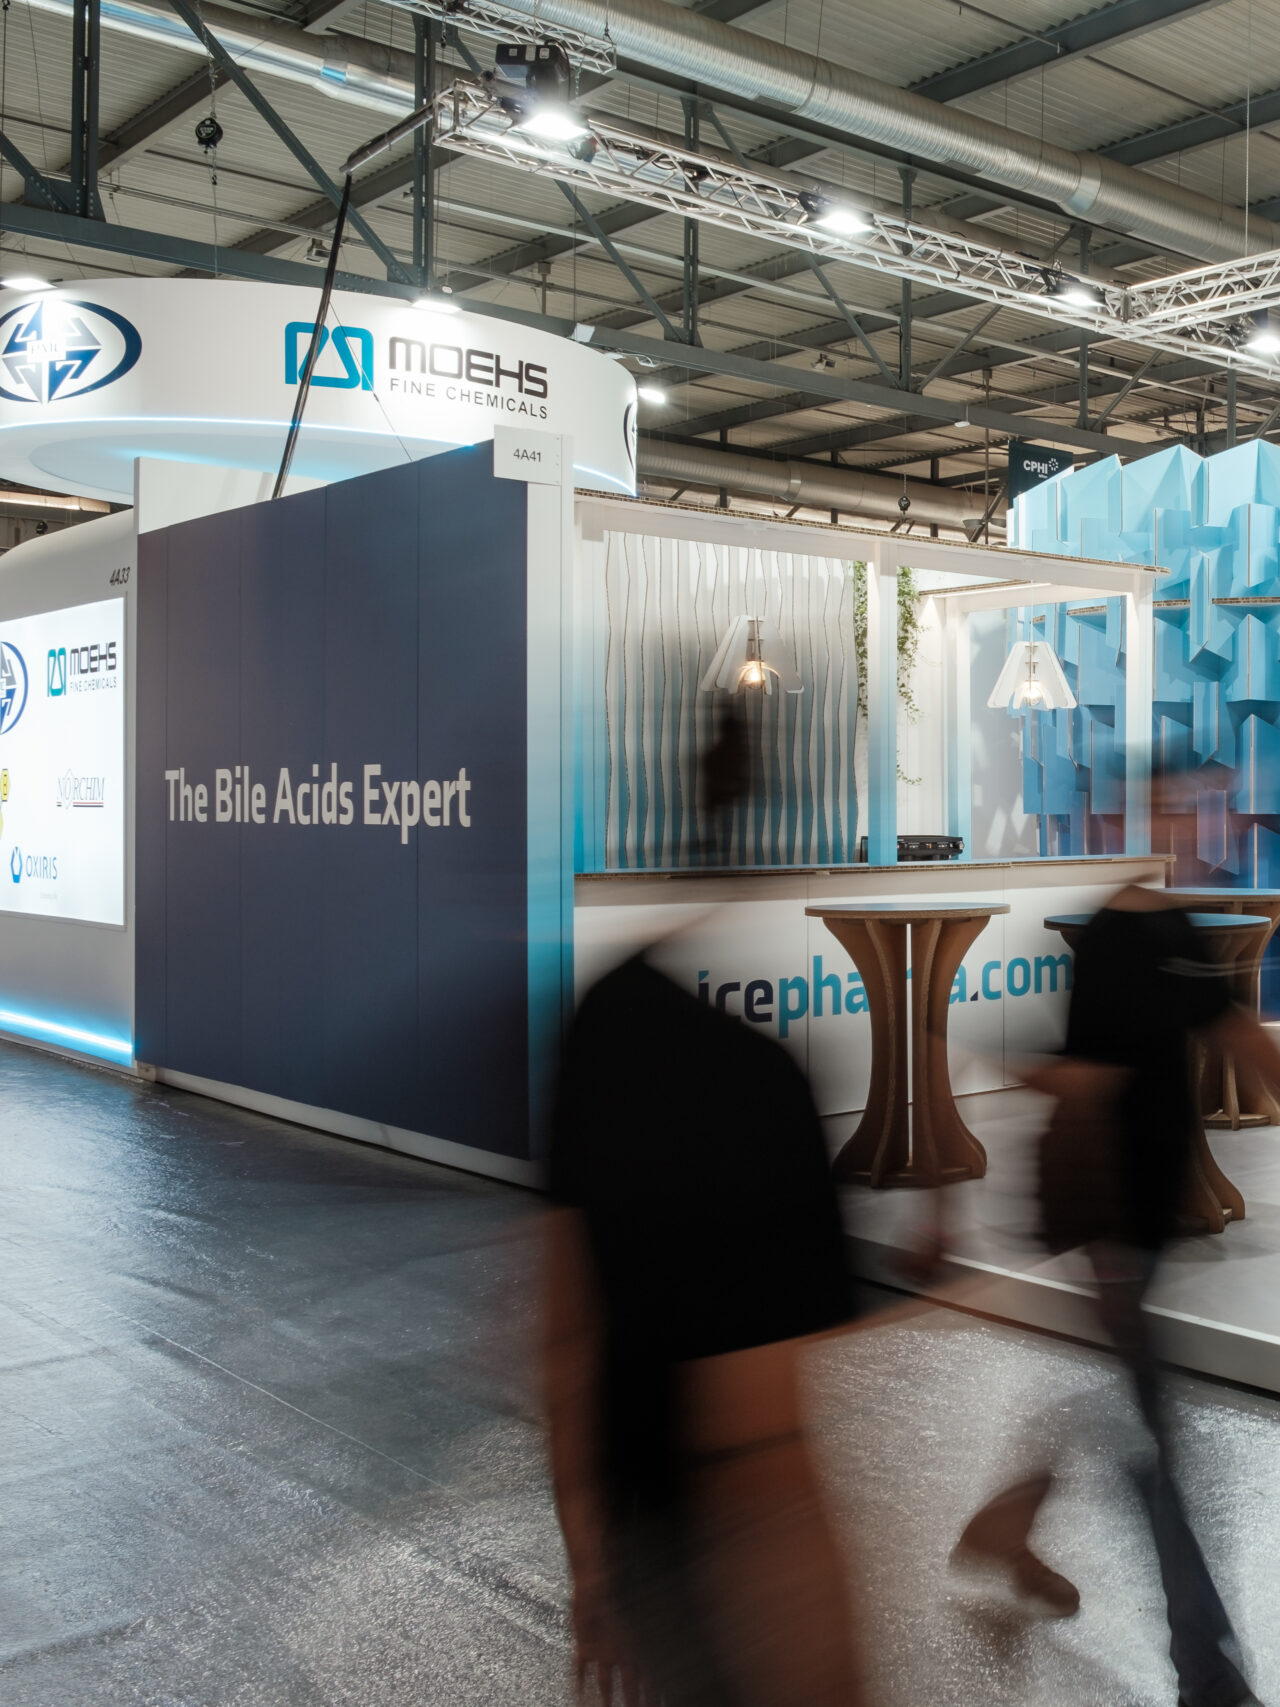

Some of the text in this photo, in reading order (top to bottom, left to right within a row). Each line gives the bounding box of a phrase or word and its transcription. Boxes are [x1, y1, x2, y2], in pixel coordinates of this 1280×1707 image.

[388, 336, 548, 399] MOEHS
[390, 378, 548, 420] FINE CHEMICALS
[513, 448, 542, 463] 4A41
[1023, 460, 1048, 474] CPHI
[109, 566, 131, 586] 4A33
[69, 641, 117, 676] MOEHS
[165, 762, 472, 845] The Bile Acids Expert
[25, 855, 58, 880] OXIRIS
